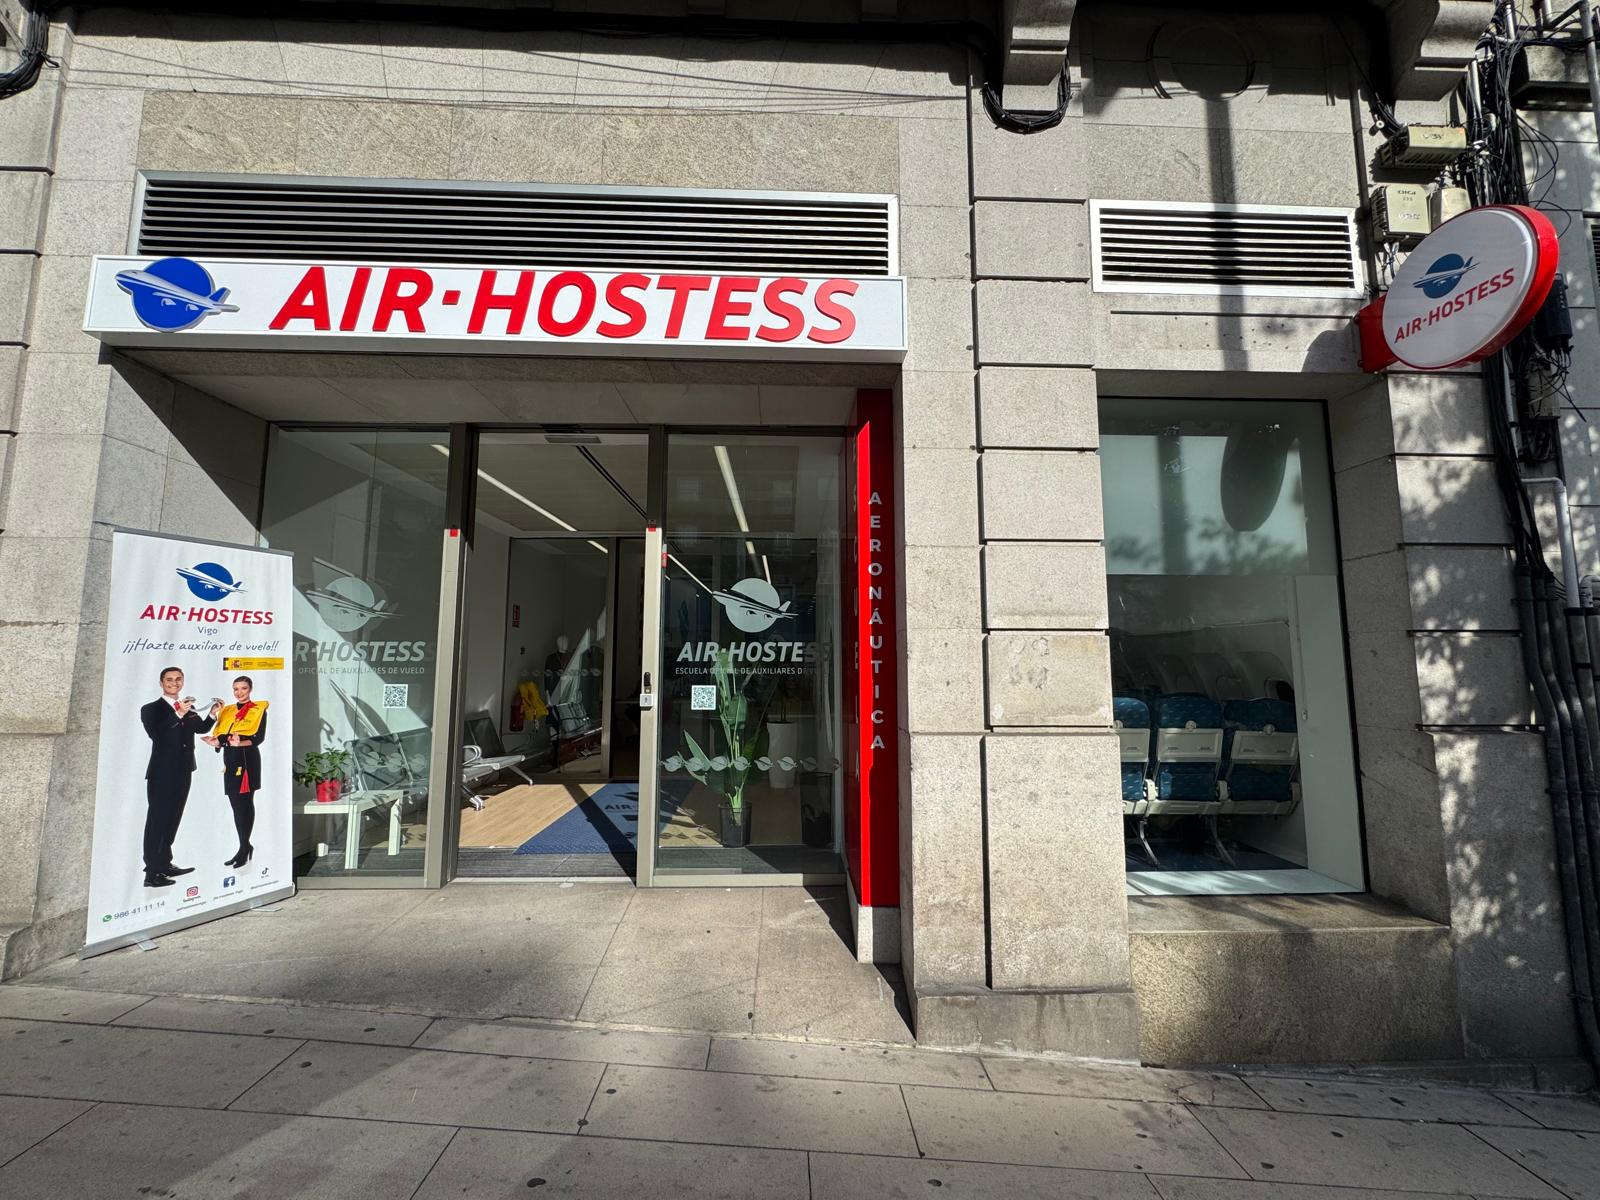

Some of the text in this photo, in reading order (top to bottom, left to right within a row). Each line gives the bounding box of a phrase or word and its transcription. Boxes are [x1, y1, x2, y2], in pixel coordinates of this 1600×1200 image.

[868, 491, 886, 750] AERONÁUTICA
[197, 626, 218, 636] Vigo
[178, 640, 225, 651] auxiliar
[228, 641, 242, 651] de
[330, 667, 339, 675] DE
[675, 667, 708, 675] ESCUELA
[740, 667, 751, 675] DE
[752, 667, 796, 675] AUXILIARES
[156, 900, 165, 908] 14
